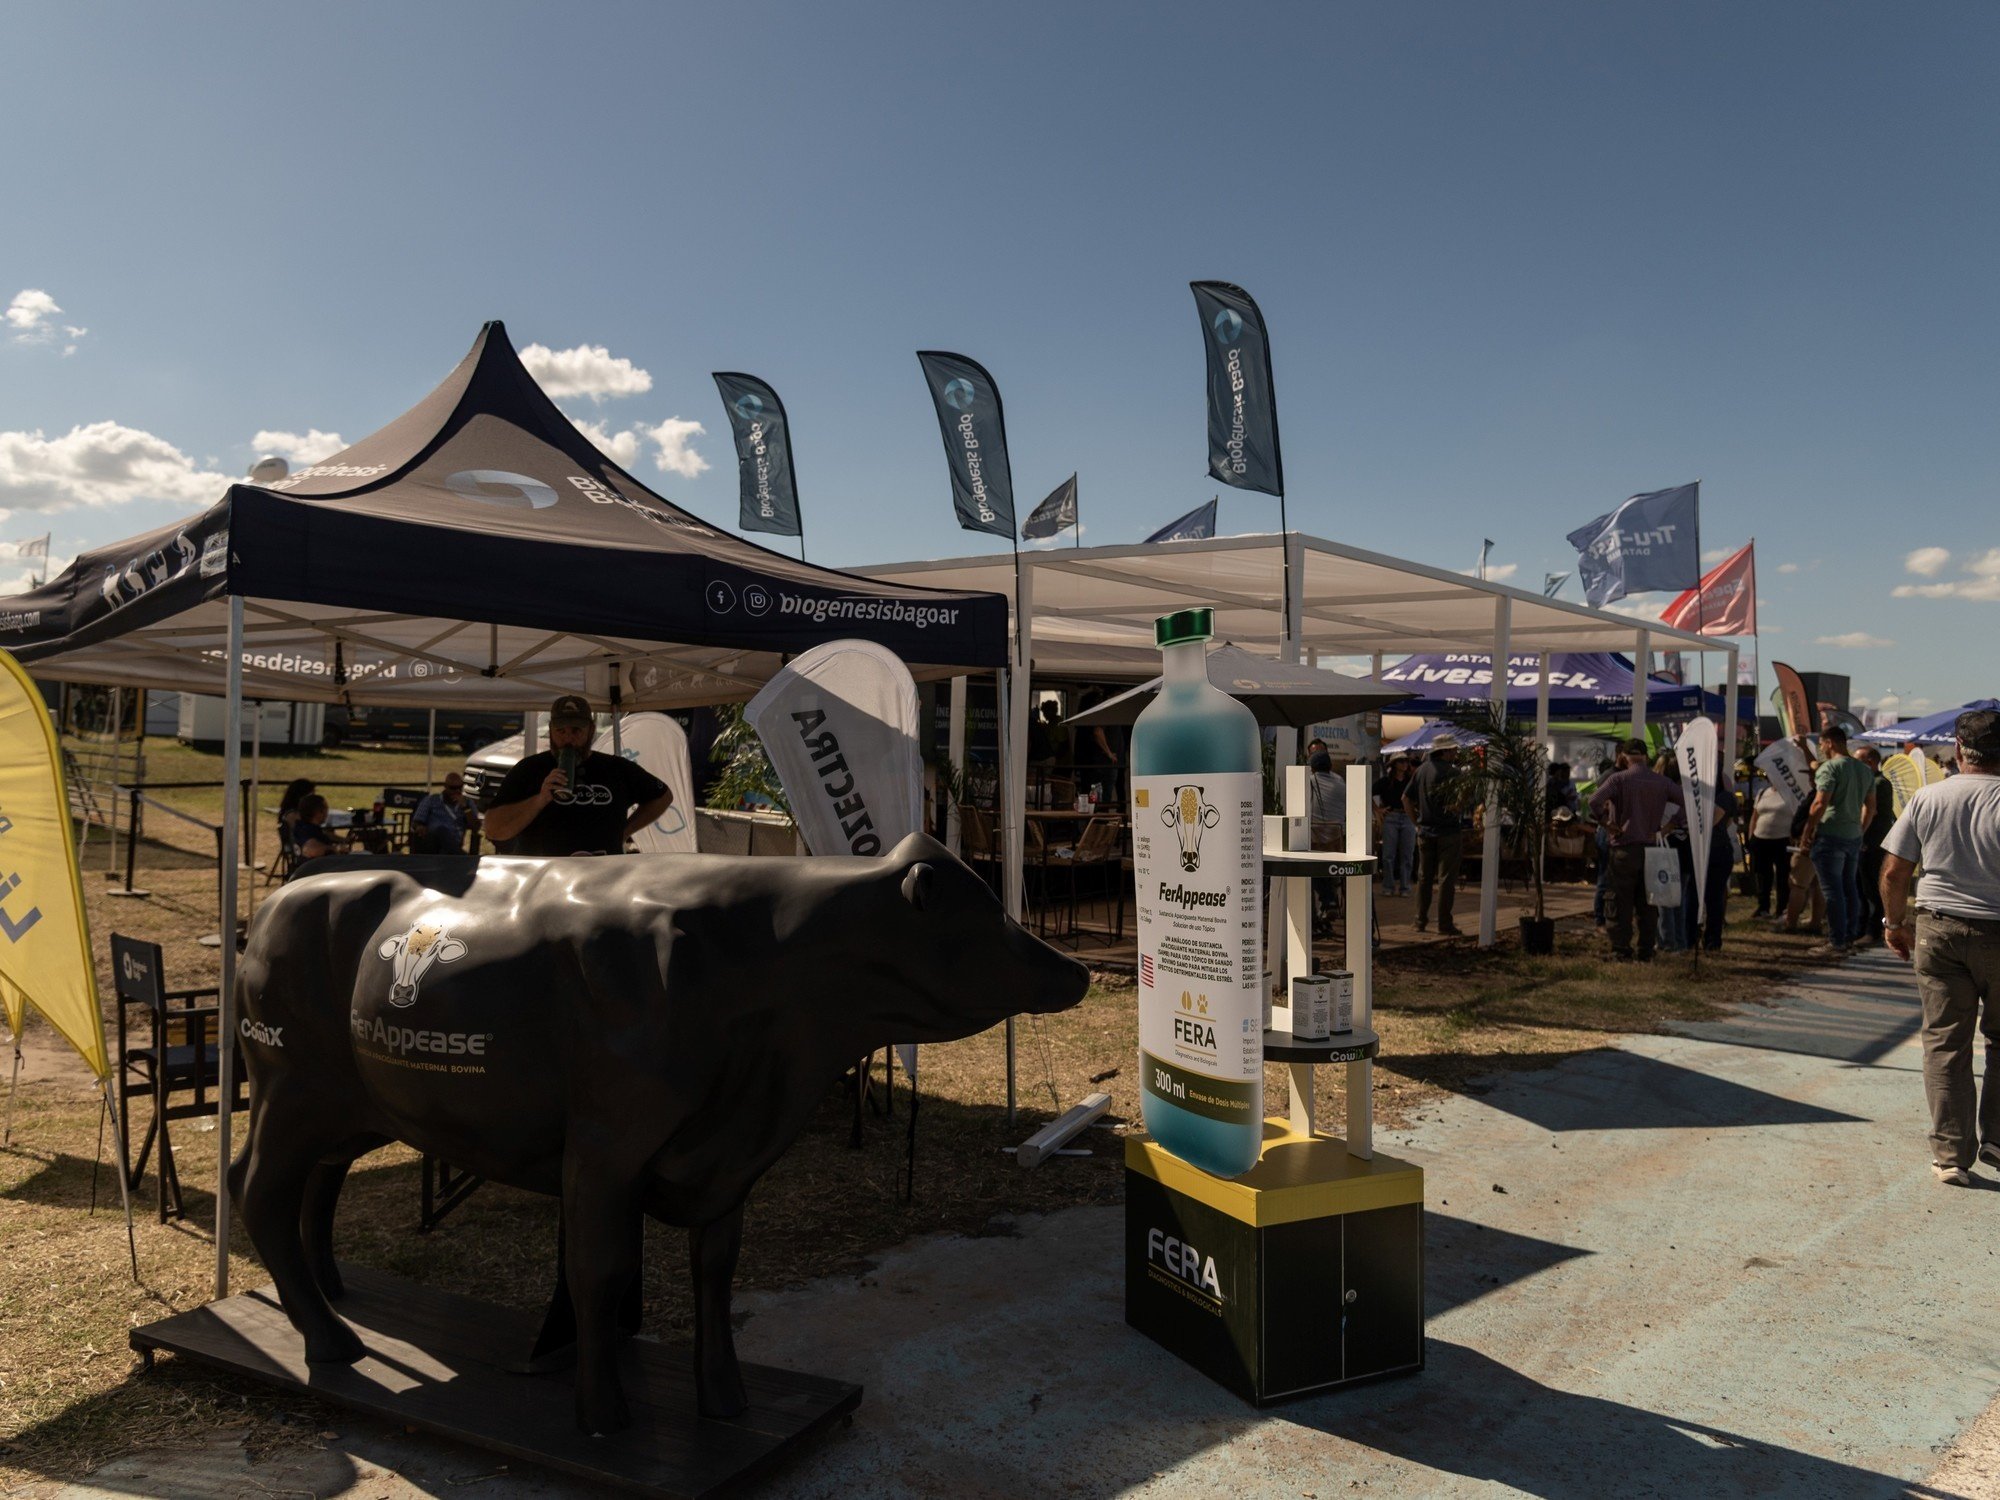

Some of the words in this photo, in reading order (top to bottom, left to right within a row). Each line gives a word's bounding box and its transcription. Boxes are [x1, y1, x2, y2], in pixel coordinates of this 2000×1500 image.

[1445, 654, 1540, 667] DATAARS
[1198, 941, 1223, 949] SUSTANCIA
[1188, 947, 1212, 957] MATERNAL
[1191, 954, 1208, 964] TÓPICO
[1176, 961, 1188, 969] SANO
[1188, 963, 1201, 971] PARA
[1201, 965, 1218, 973] MITIGAR
[1174, 1018, 1217, 1050] FERA
[451, 1065, 486, 1074] BOVINA
[1155, 1068, 1172, 1093] 300
[1173, 1082, 1186, 1100] ml
[1207, 1096, 1215, 1105] de
[1147, 1227, 1222, 1299] FERA
